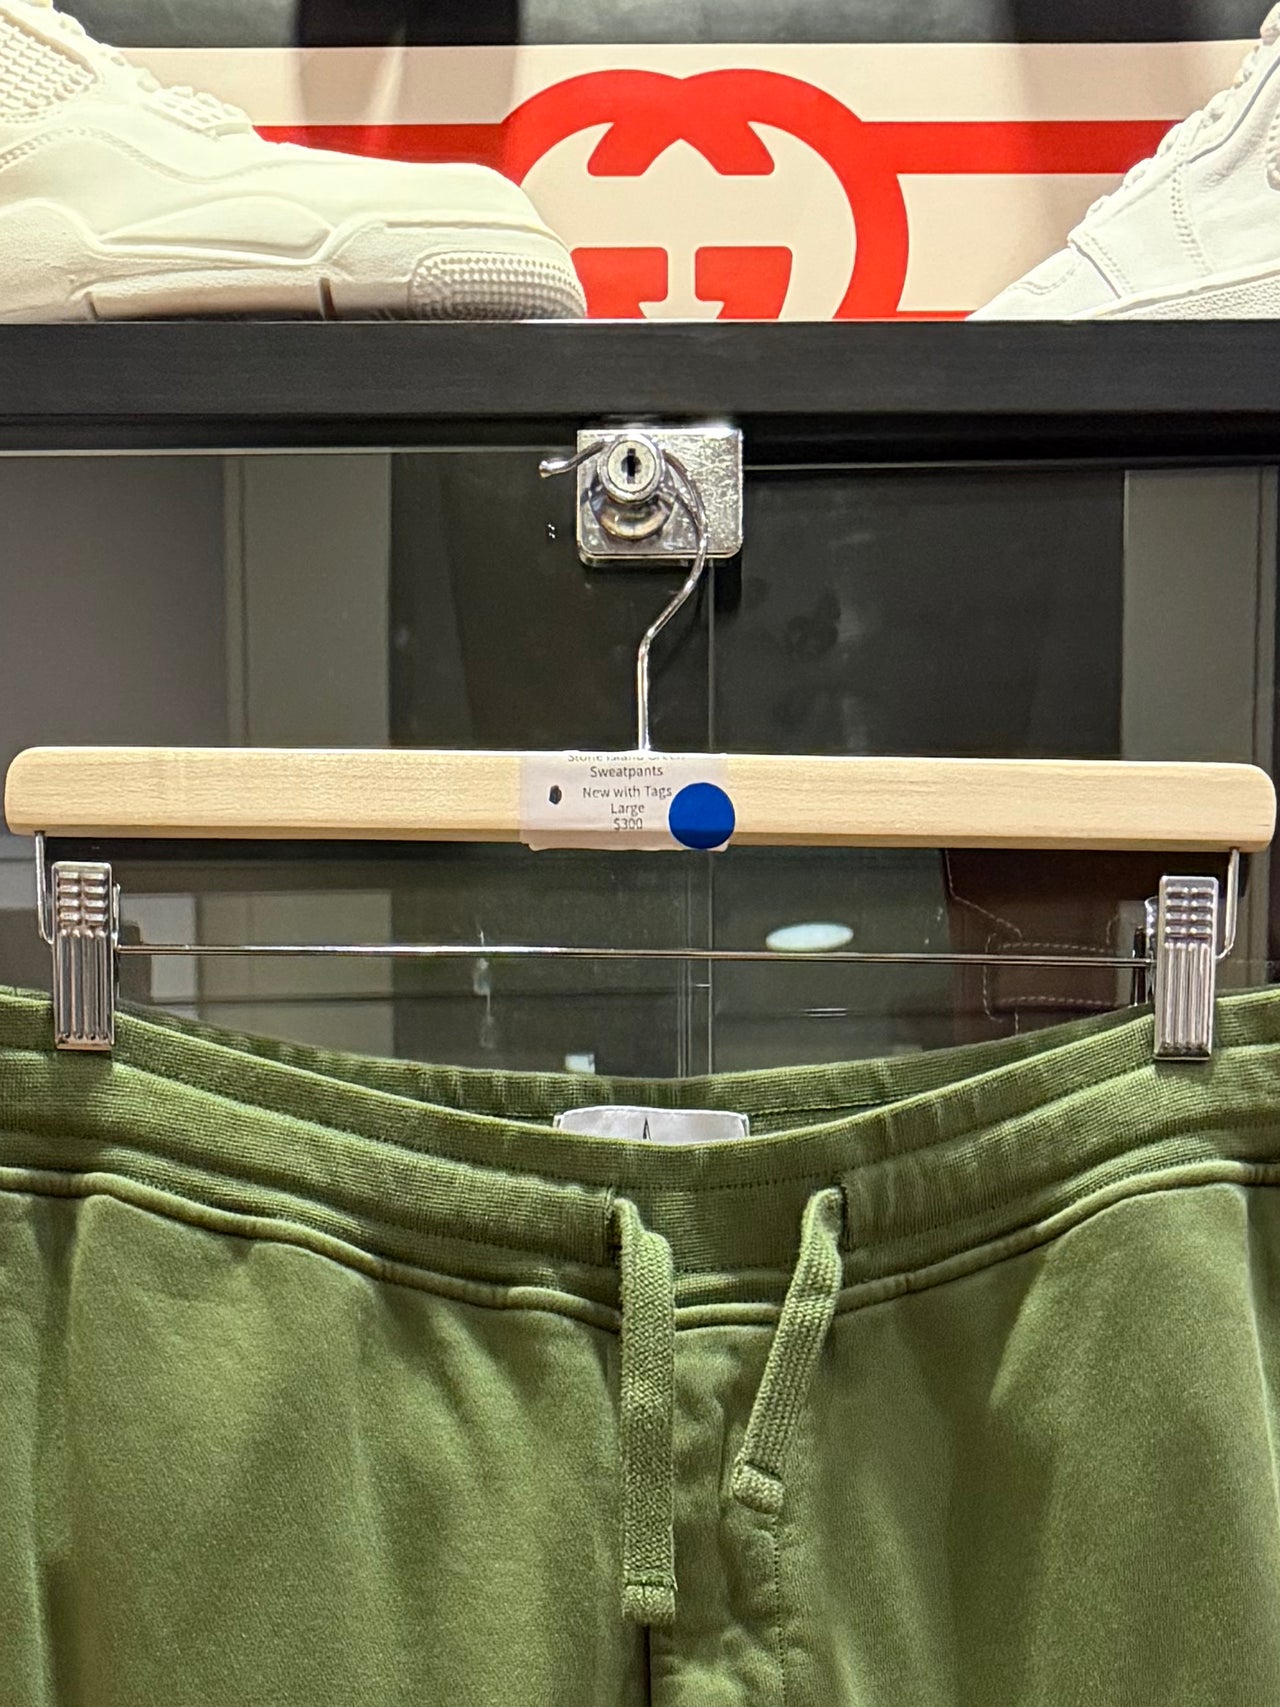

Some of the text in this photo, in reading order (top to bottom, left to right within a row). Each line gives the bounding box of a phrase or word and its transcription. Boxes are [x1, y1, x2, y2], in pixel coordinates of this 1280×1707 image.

[589, 765, 664, 779] Sweatpants
[582, 785, 673, 799] New with Tags
[610, 803, 645, 816] Large
[613, 817, 643, 831] $300
